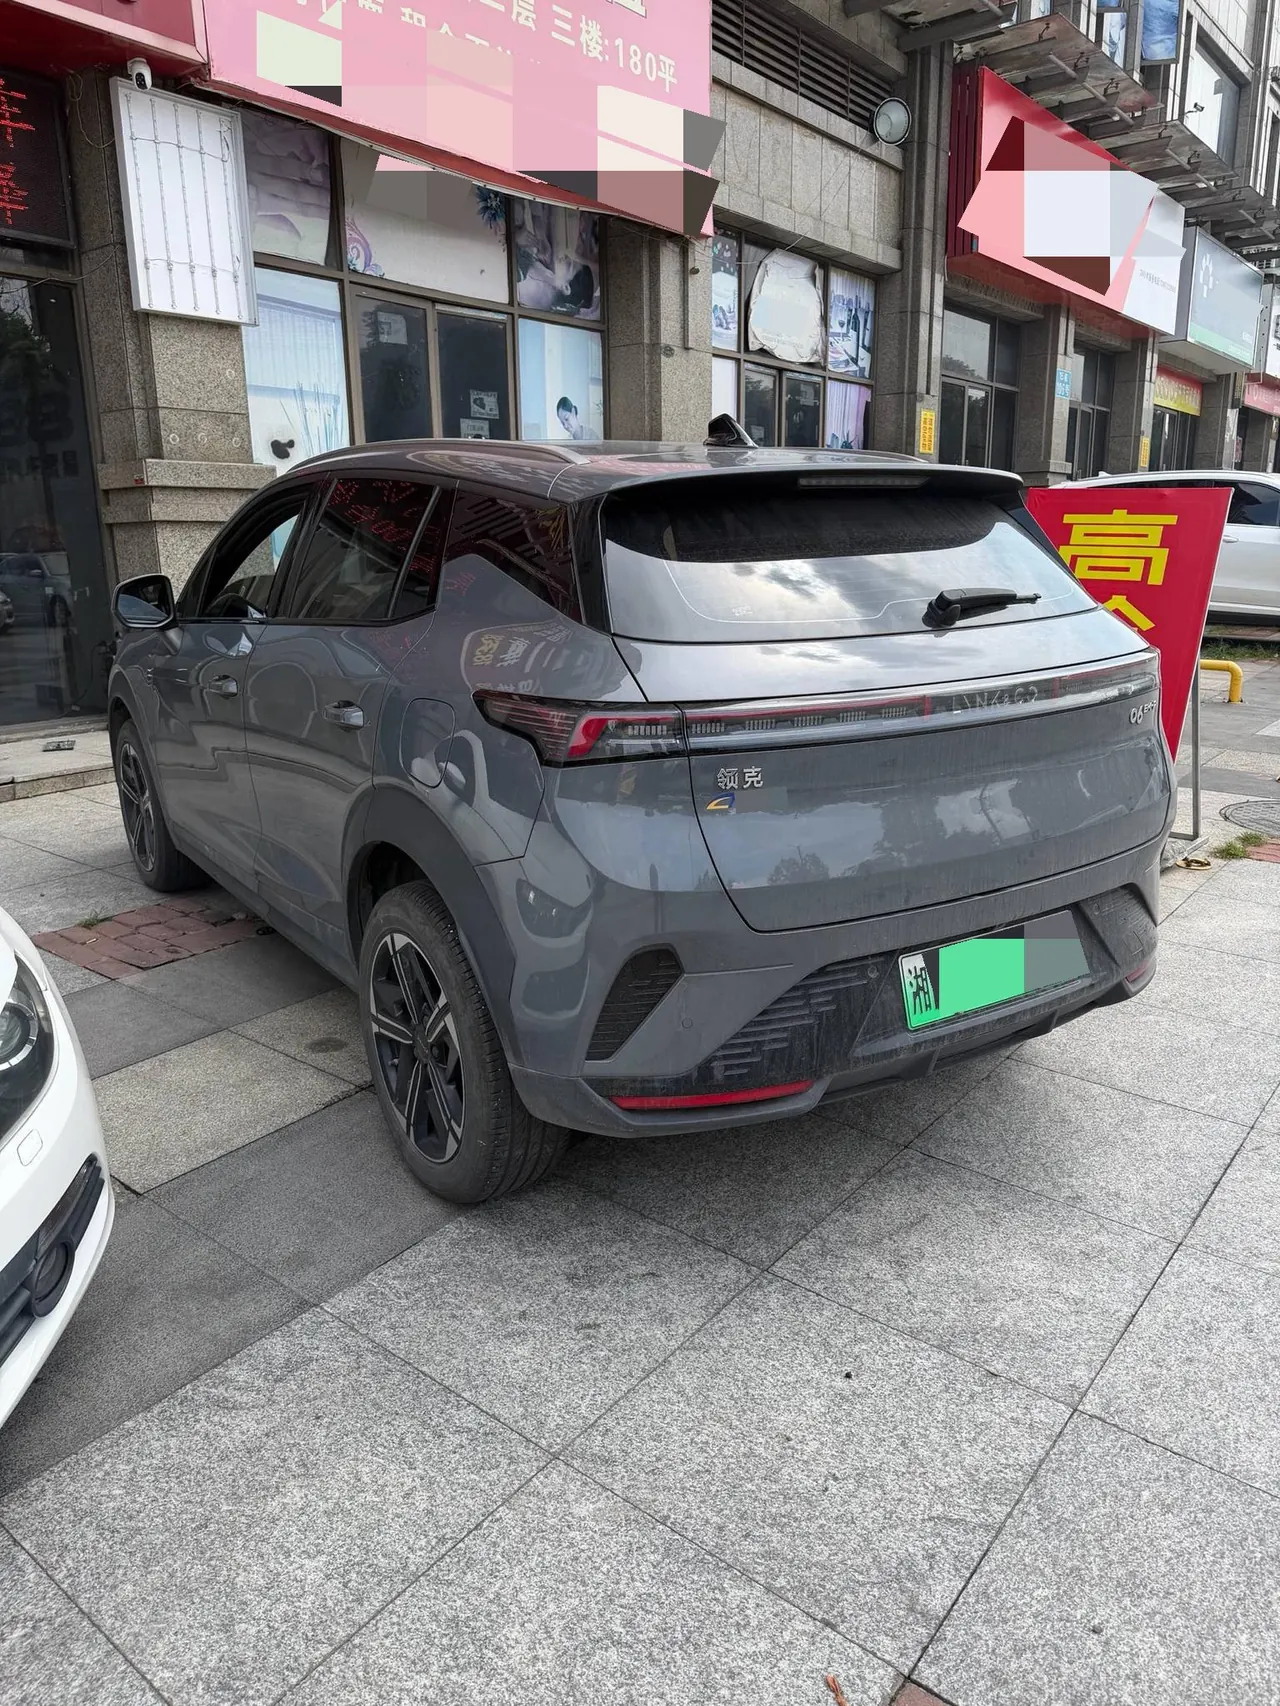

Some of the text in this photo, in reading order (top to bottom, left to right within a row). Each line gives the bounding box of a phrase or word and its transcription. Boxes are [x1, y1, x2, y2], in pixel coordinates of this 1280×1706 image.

[480, 0, 536, 31] 层
[716, 765, 764, 790] 领克
[908, 966, 932, 1015] 湘
